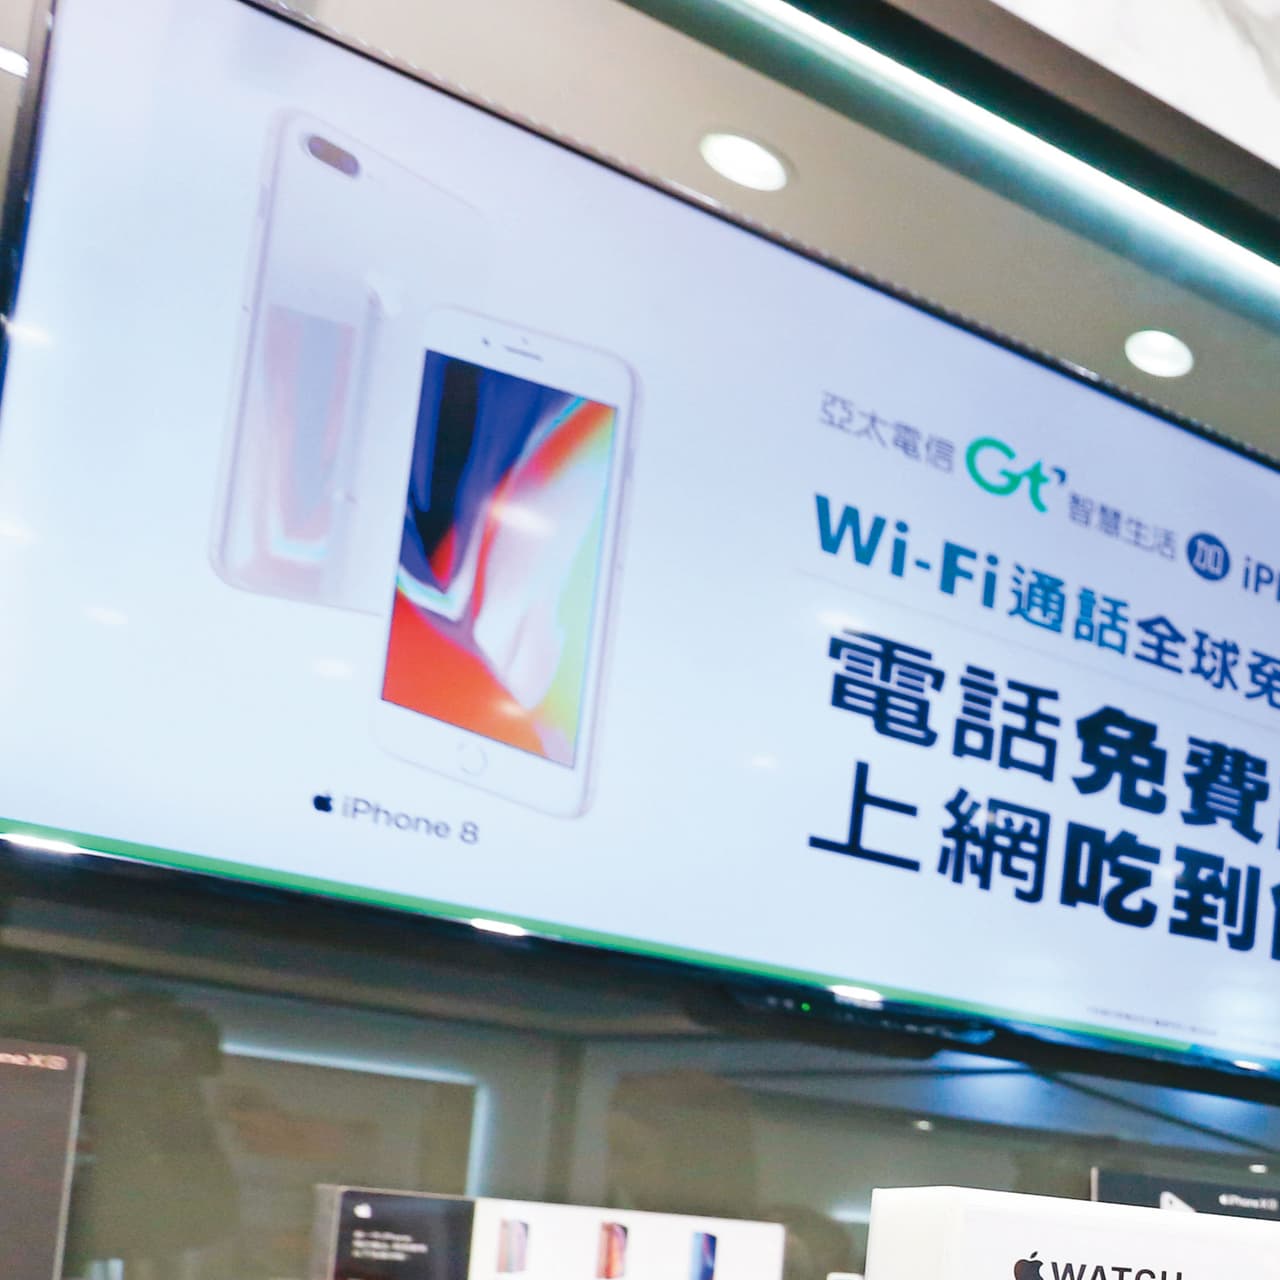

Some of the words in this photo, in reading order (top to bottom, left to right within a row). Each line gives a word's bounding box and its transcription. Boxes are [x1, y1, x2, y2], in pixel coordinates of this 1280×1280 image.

[819, 391, 955, 474] 亞太電信
[965, 436, 1051, 514] Gt
[1069, 492, 1177, 562] 智慧生活
[342, 795, 451, 839] iPhone
[459, 820, 480, 846] 8
